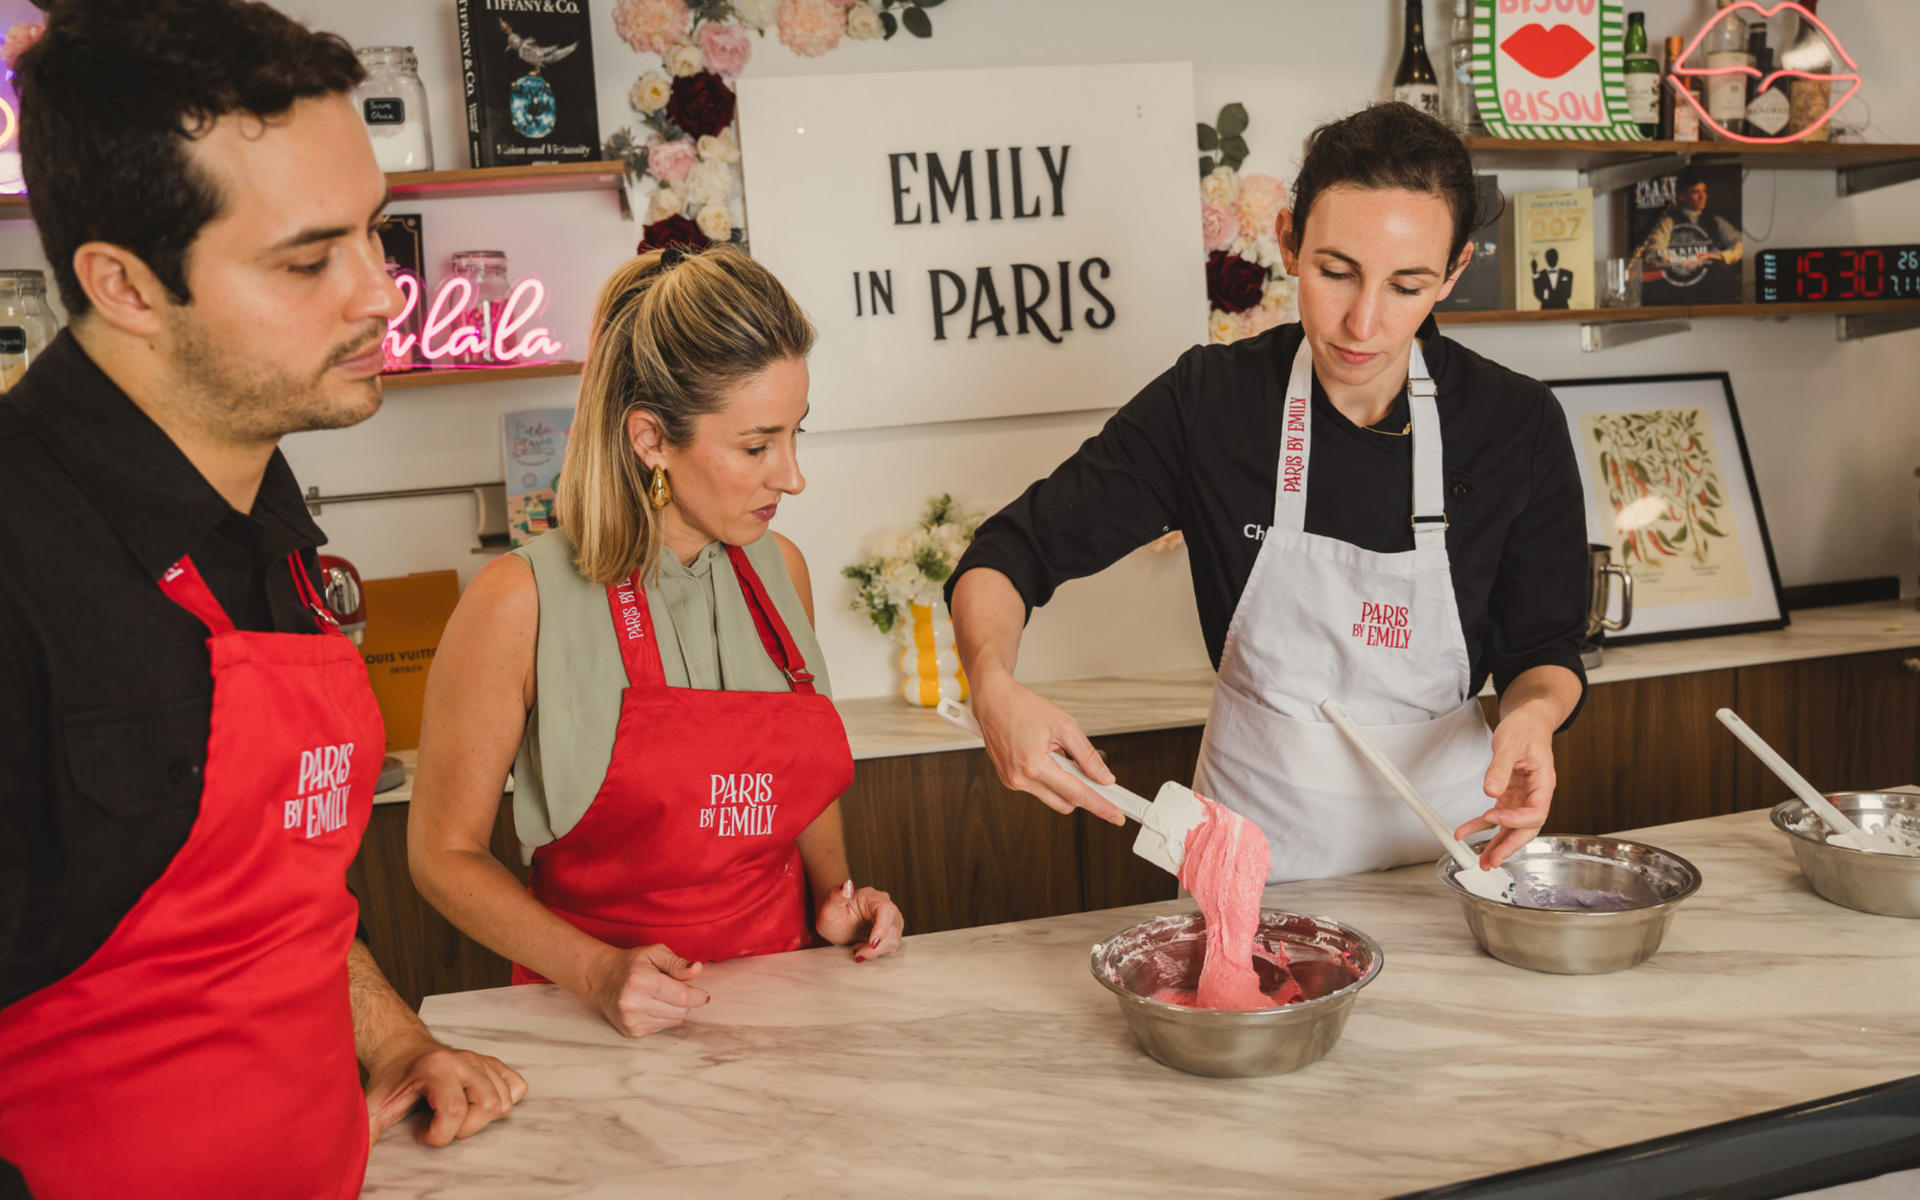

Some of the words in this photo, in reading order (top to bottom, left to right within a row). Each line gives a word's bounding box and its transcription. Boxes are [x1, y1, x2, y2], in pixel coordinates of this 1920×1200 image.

[464, 59, 473, 70] &
[1503, 88, 1604, 123] BISOU
[888, 145, 1071, 225] EMILY
[1529, 217, 1582, 239] 007
[853, 269, 895, 317] IN
[927, 257, 1115, 343] PARIS
[1287, 397, 1306, 431] EMILY
[1286, 435, 1304, 452] BY
[1283, 455, 1304, 493] PARIS
[618, 591, 636, 604] BY
[622, 606, 644, 640] PARIS
[1361, 601, 1408, 629] PARIS
[1352, 623, 1365, 638] BY
[1366, 626, 1412, 649] EMILY
[297, 742, 354, 795] PARIS
[710, 773, 773, 807] PARIS
[284, 798, 303, 829] BY
[306, 784, 351, 839] EMILY
[699, 808, 716, 828] BY
[718, 804, 778, 837] EMILY
